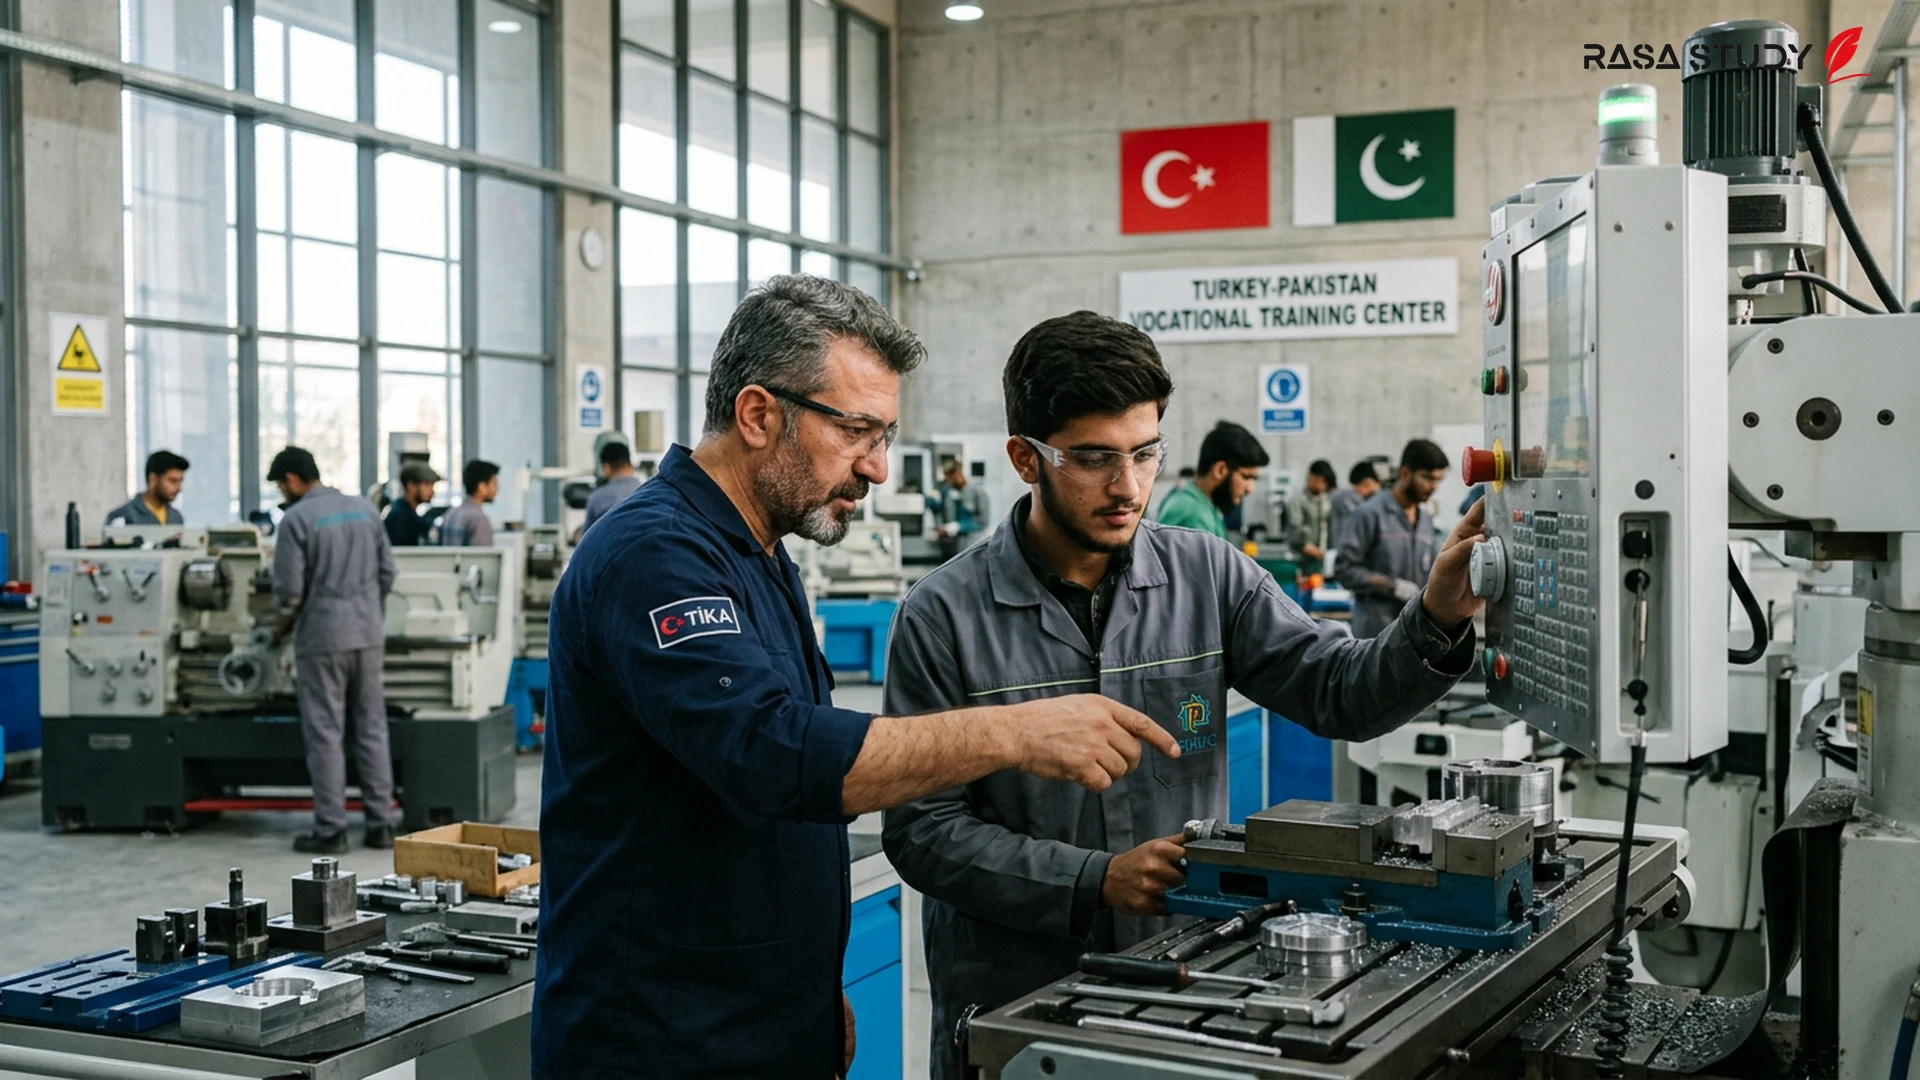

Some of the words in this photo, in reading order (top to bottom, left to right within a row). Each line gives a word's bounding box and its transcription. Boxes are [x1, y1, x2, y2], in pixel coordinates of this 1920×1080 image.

[1192, 273, 1377, 300] TURKEY-PAKISTAN
[1129, 308, 1251, 332] VOCATIONAL
[1260, 303, 1356, 328] TRAINING
[1364, 301, 1446, 324] CENTER
[683, 606, 733, 626] TİKA
